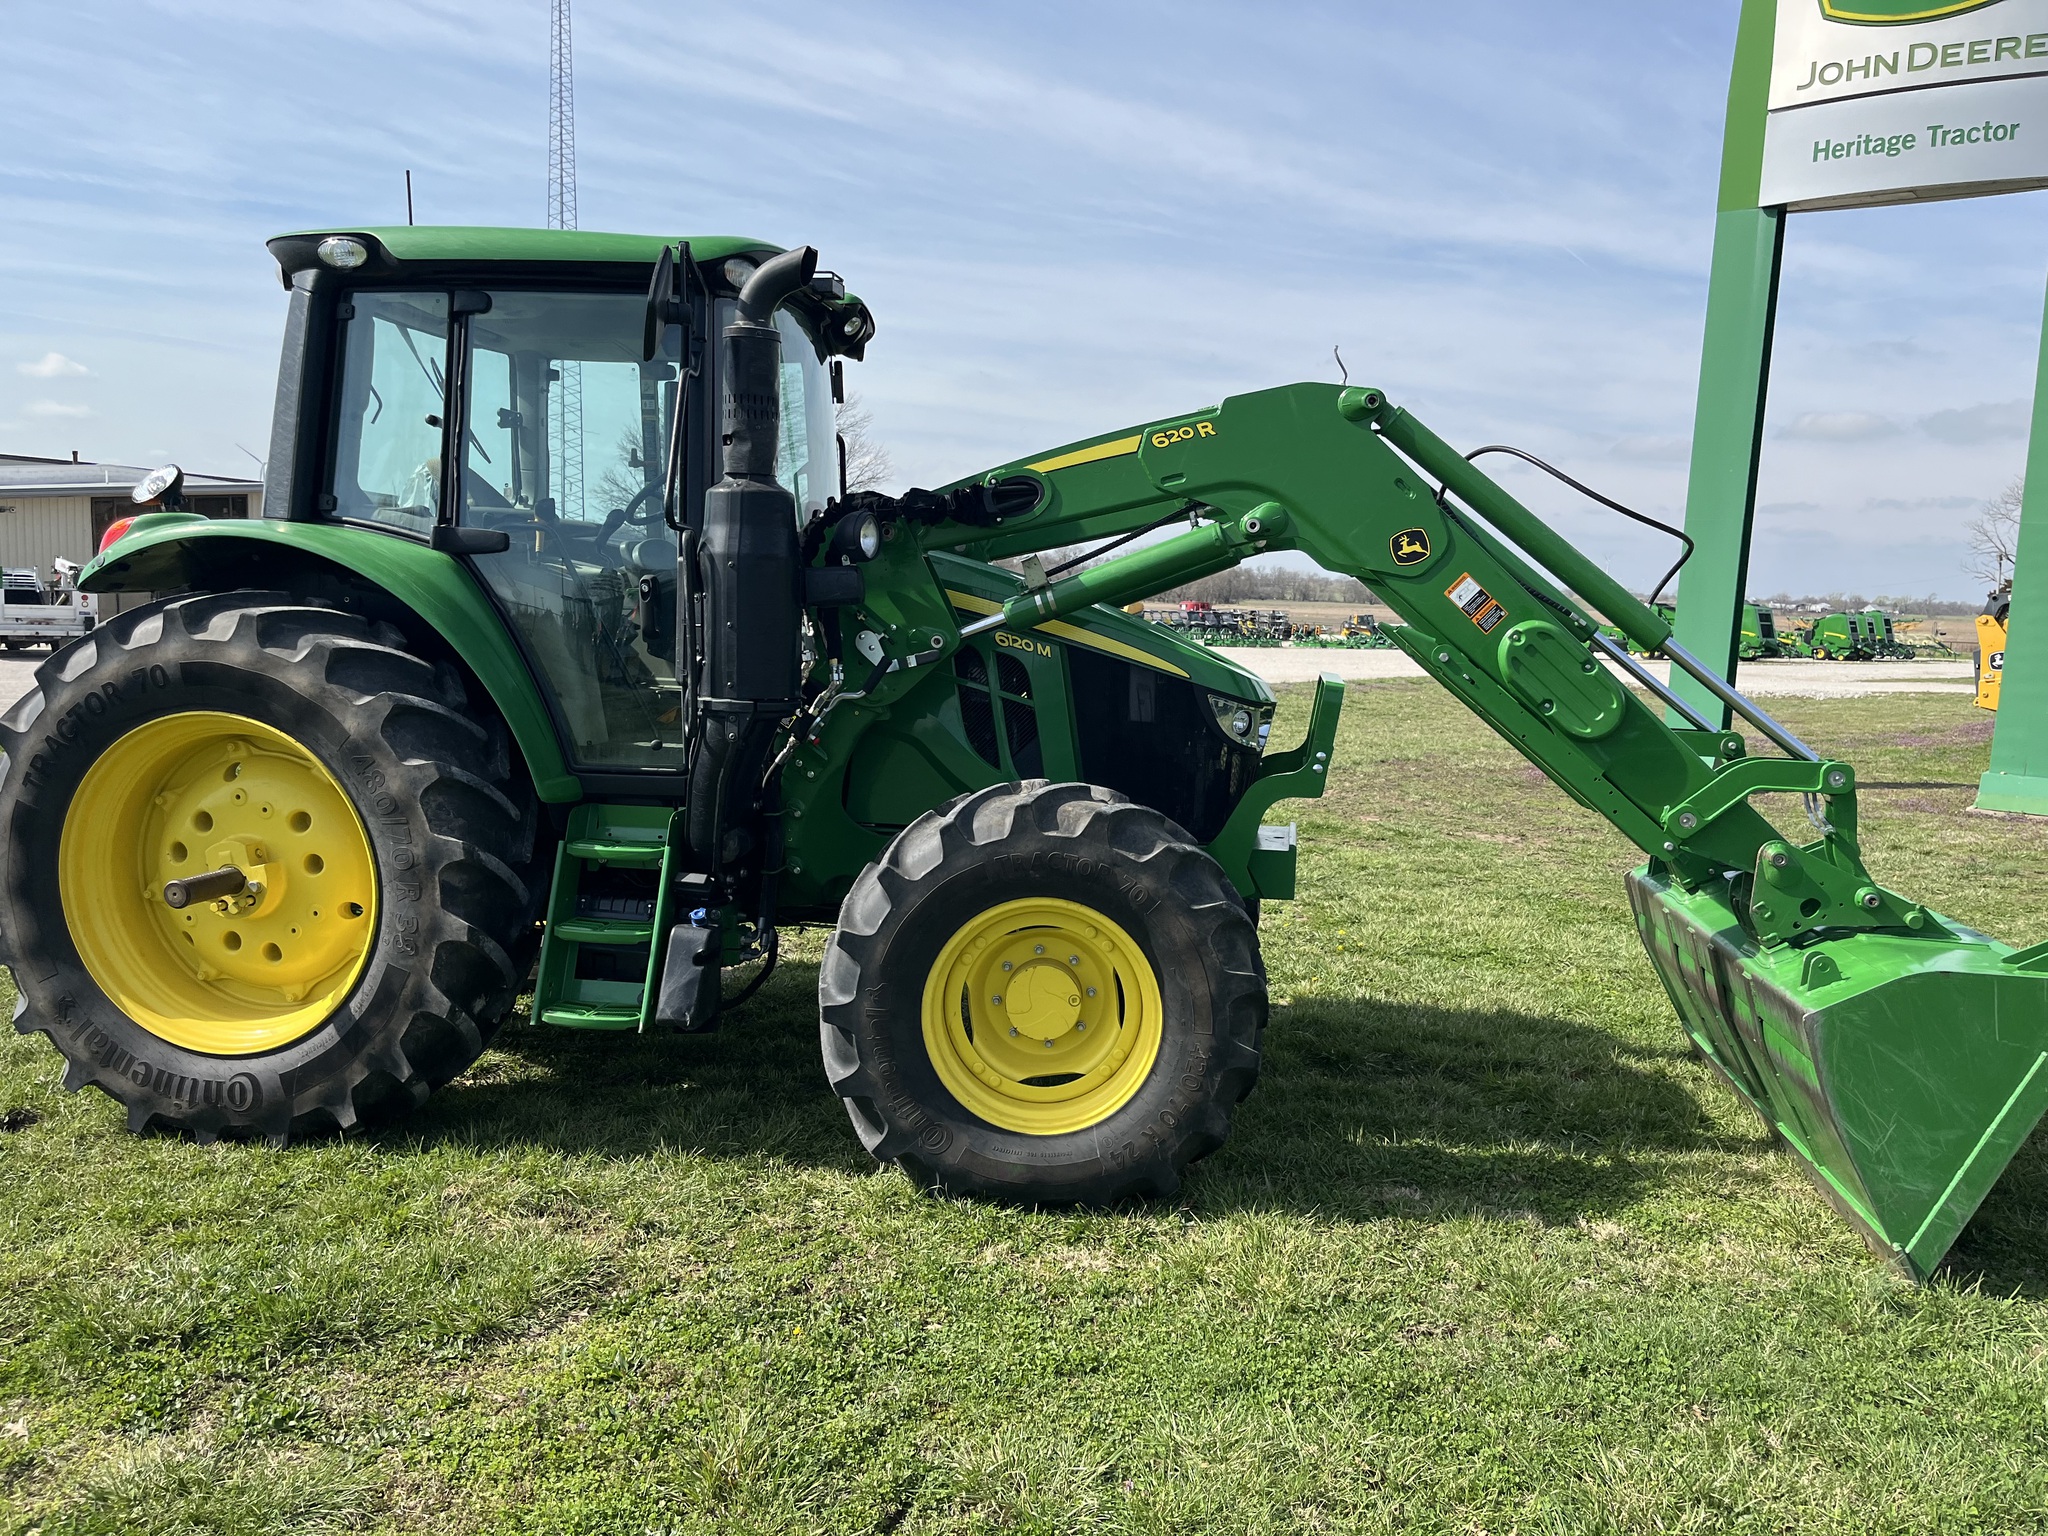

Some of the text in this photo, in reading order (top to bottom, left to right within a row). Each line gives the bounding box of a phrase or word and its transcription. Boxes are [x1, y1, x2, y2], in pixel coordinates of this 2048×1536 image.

[1796, 33, 2048, 91] JOHN DEERE
[1812, 121, 2020, 163] Heritage Tractor
[1151, 421, 1217, 448] 620 R
[994, 631, 1052, 658] 6120 M
[21, 662, 171, 789] TRACTOR 70
[994, 851, 1149, 905] TRACTOR 70
[69, 1017, 264, 1113] Continental
